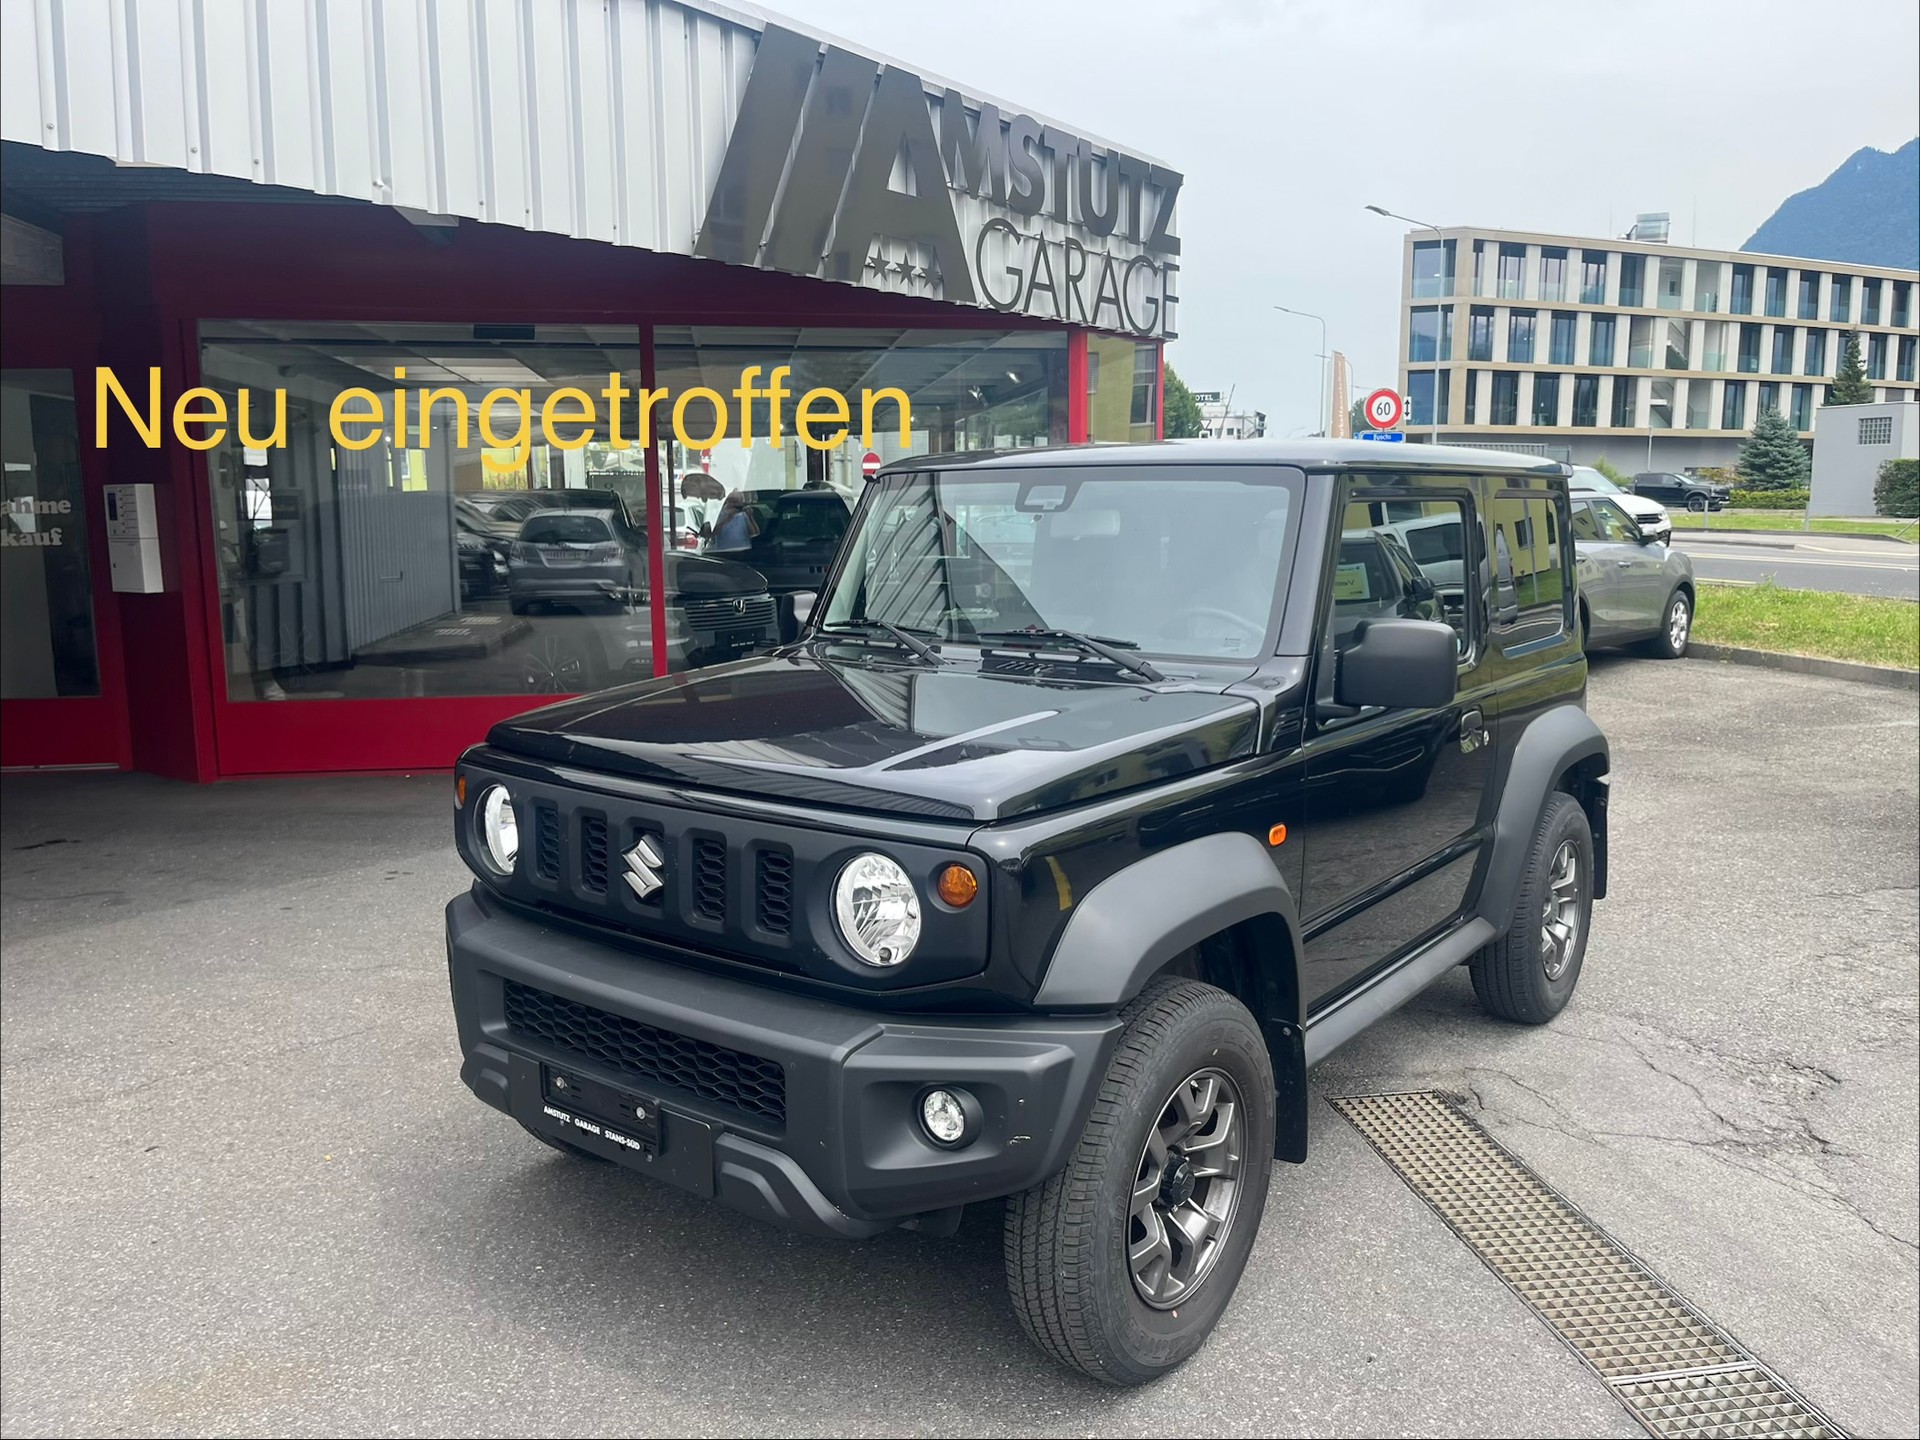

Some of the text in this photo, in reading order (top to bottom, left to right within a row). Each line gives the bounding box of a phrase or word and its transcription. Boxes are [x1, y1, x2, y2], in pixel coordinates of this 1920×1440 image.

[824, 63, 1185, 304] AMSTUTZ
[975, 217, 1181, 340] GARAGE
[1194, 394, 1214, 402] OTEL
[1376, 401, 1391, 416] 60
[543, 1105, 571, 1123] AMSTUTZ
[574, 1118, 601, 1136] GARAGE
